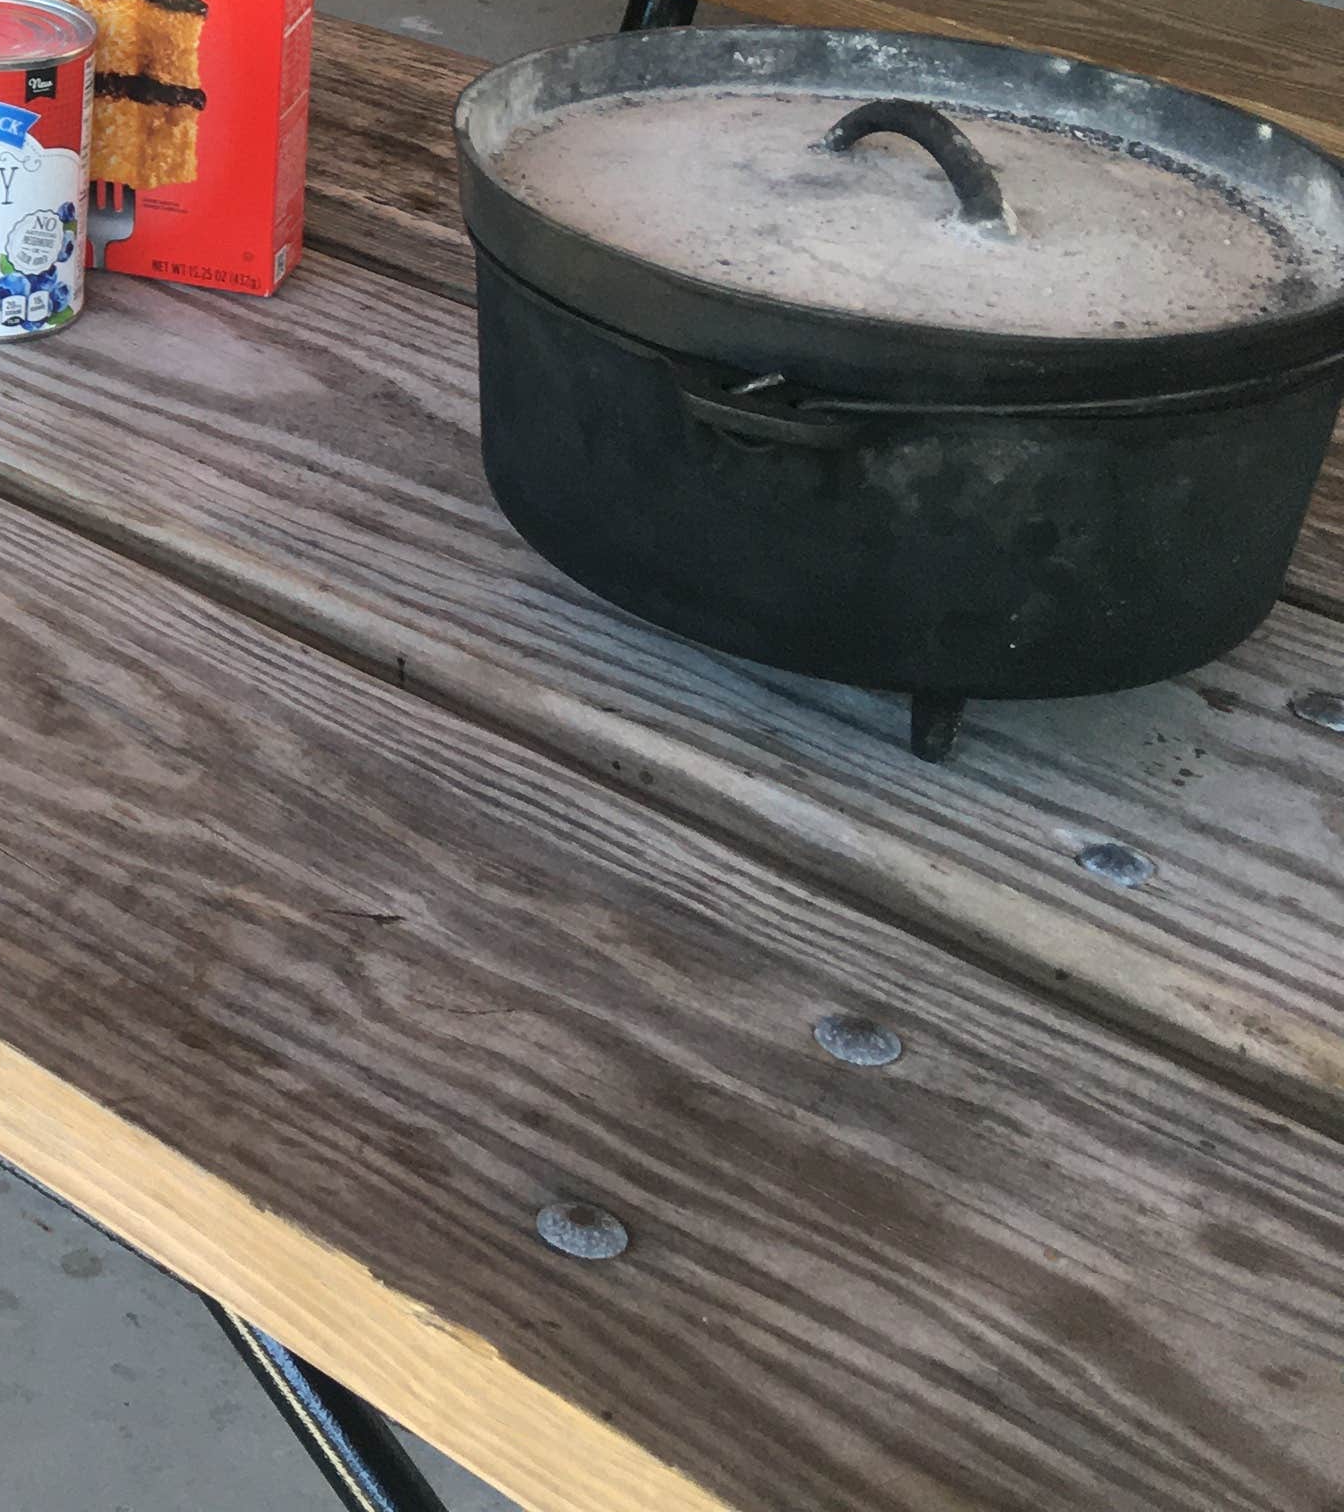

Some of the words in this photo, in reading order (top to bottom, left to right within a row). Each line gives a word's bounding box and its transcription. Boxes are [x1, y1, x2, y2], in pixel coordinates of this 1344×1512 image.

[31, 215, 58, 232] NO
[152, 260, 169, 273] NET
[171, 263, 186, 275] WT
